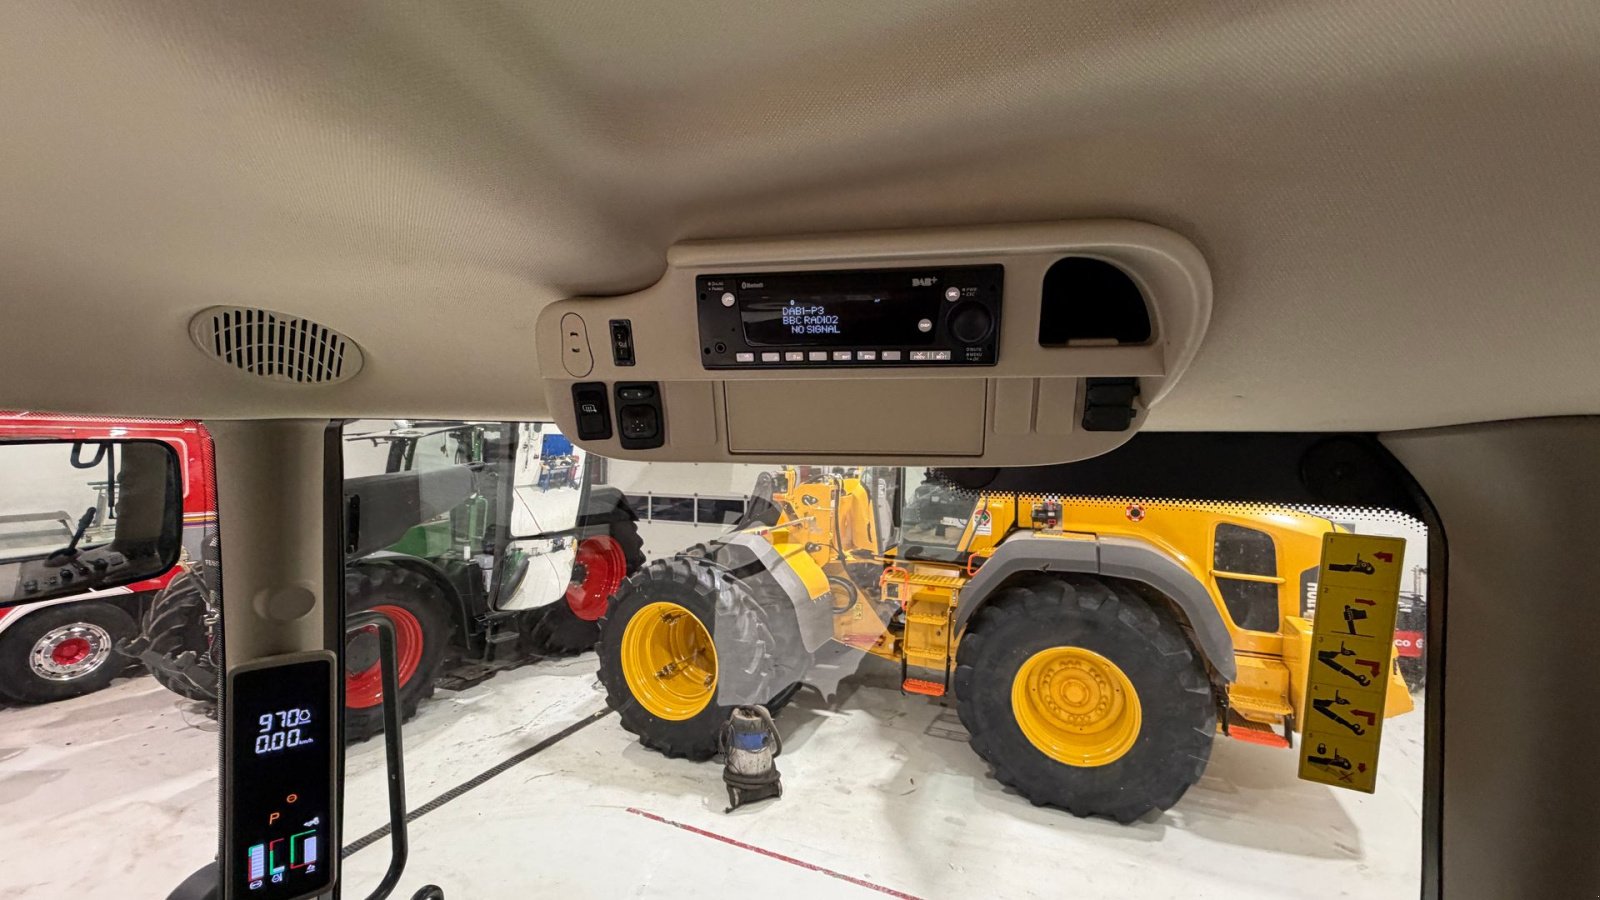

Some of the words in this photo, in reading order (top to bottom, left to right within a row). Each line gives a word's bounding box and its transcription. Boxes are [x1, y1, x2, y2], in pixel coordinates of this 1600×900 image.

[782, 306, 825, 316] DAB1-P3
[782, 316, 802, 325] BBC
[803, 316, 839, 325] RADIO2
[791, 325, 805, 334] NO
[806, 325, 841, 334] SIGNAL
[259, 708, 301, 733] 970
[255, 728, 301, 754] 0.00
[269, 812, 280, 825] P
